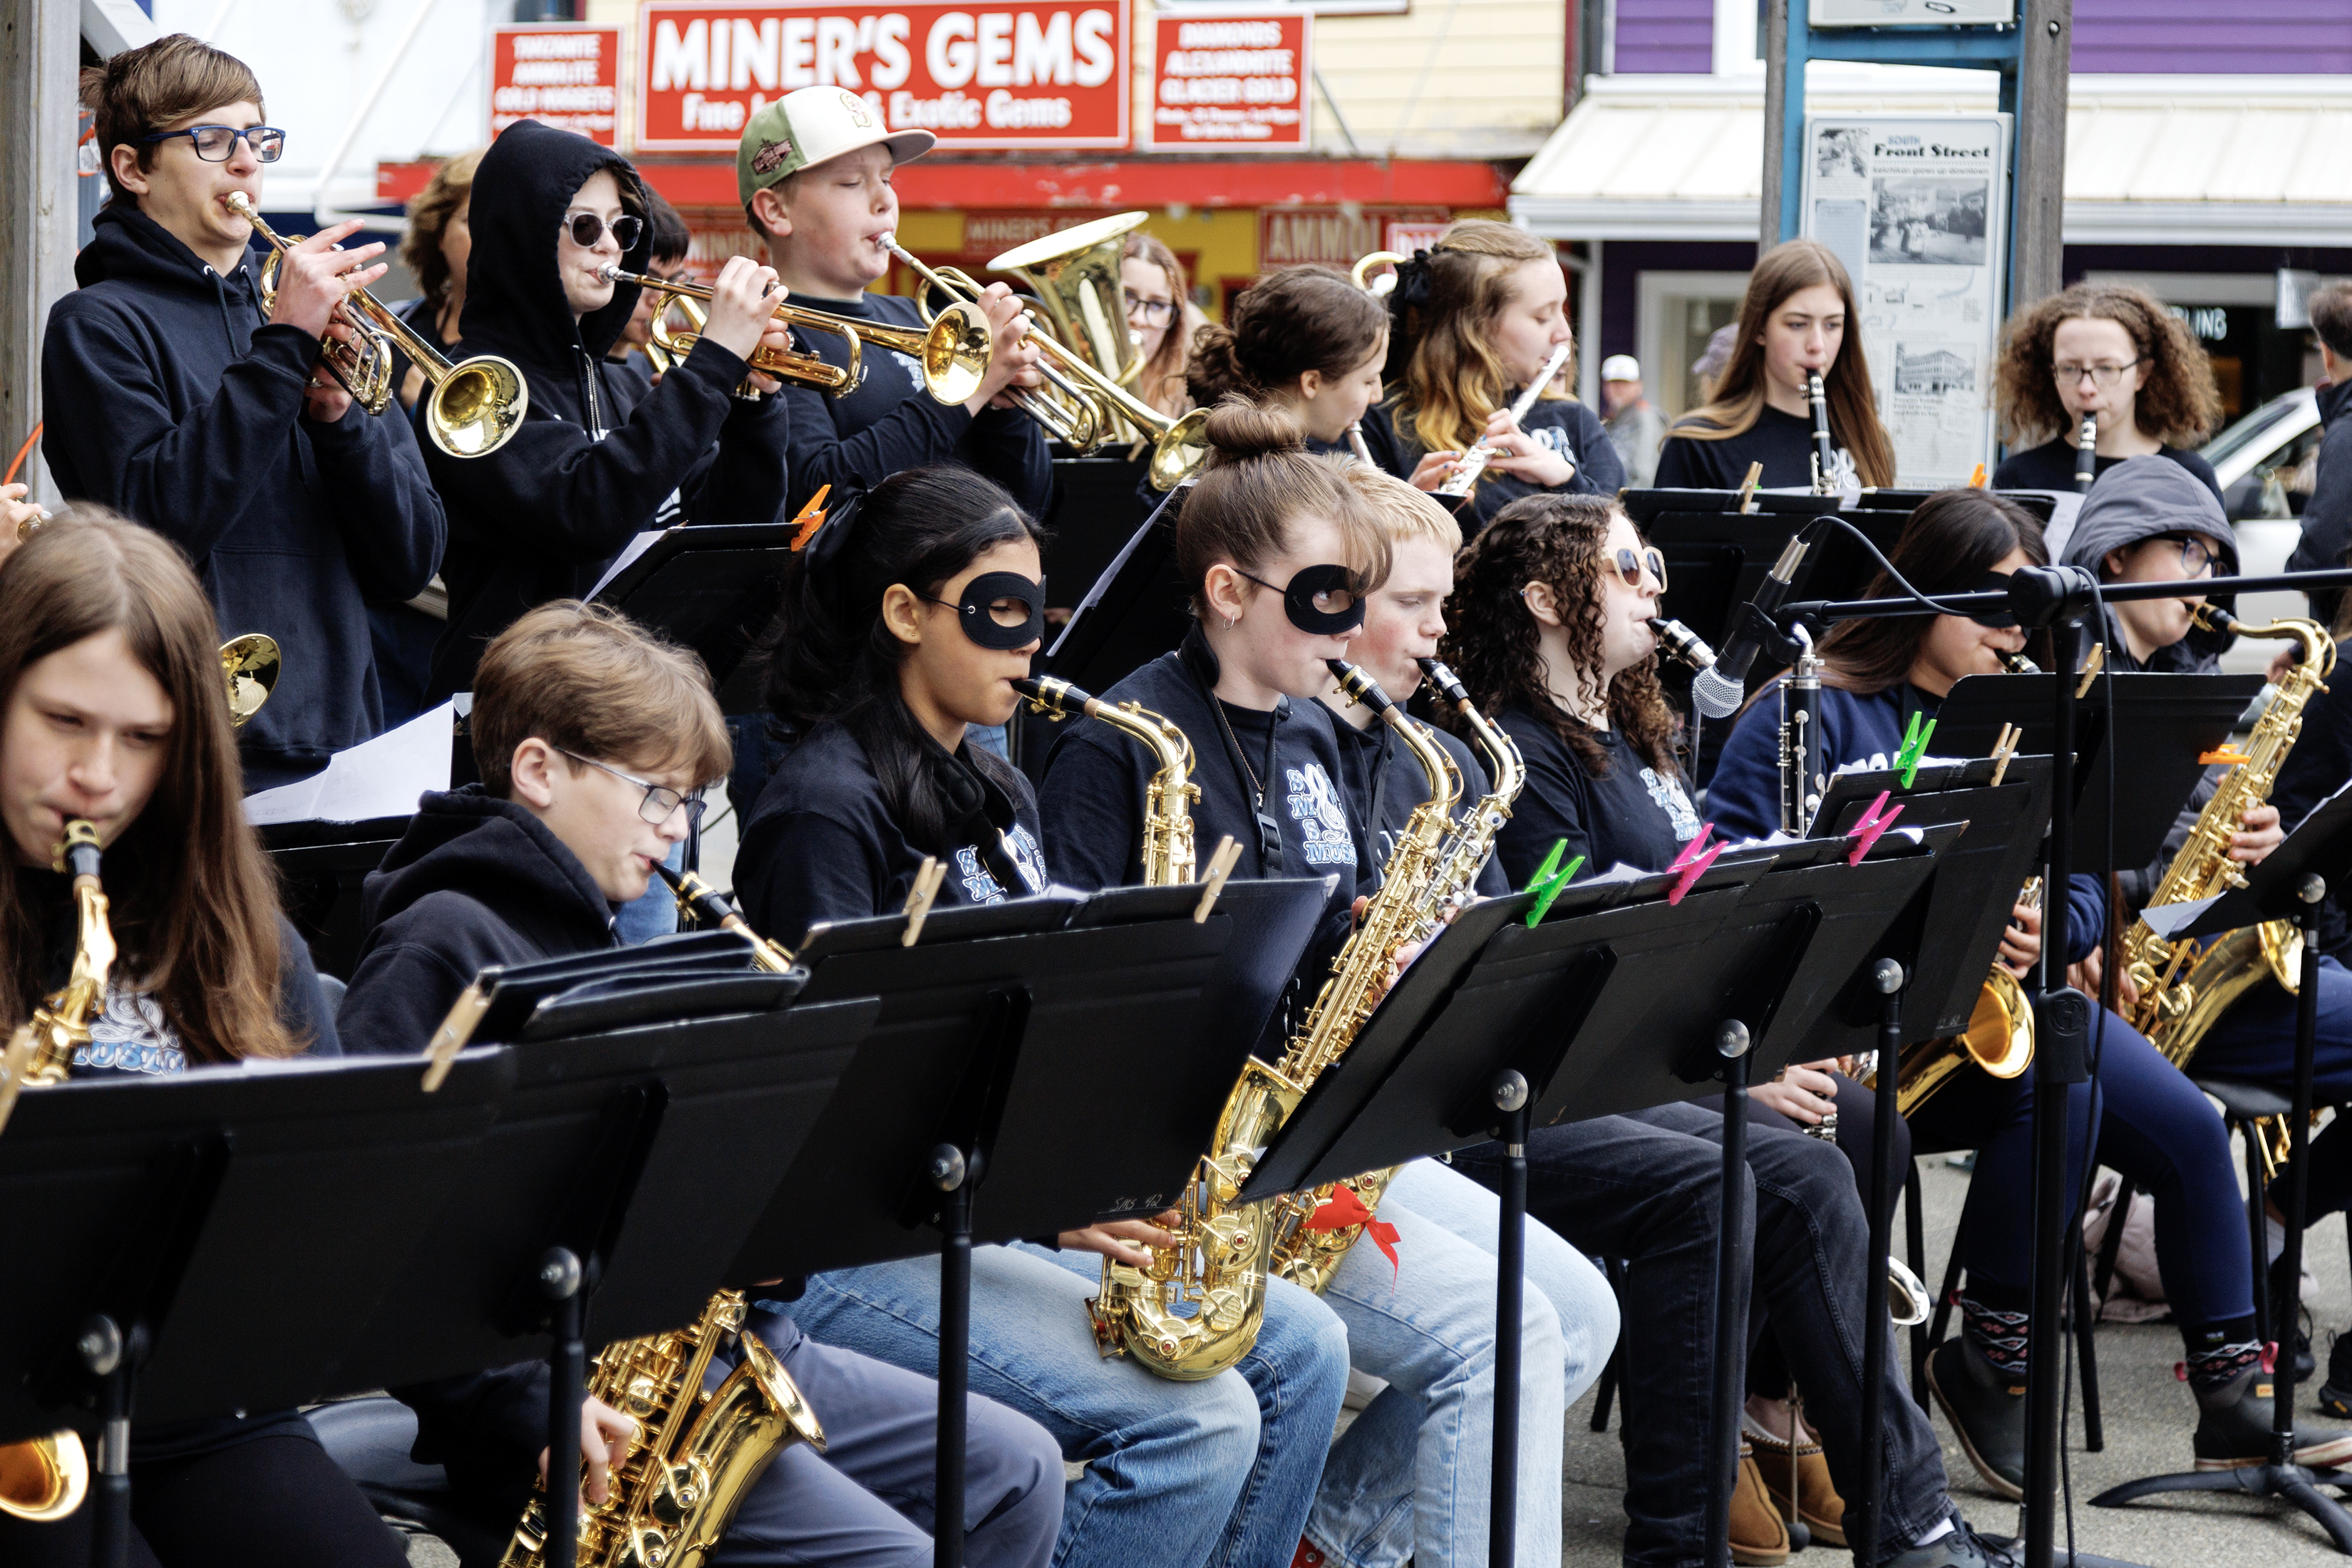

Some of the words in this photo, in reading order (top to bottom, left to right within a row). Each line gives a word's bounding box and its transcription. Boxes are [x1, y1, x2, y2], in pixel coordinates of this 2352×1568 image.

[651, 13, 912, 91] MINER'S
[926, 9, 1115, 89] GEMS
[495, 86, 539, 112] GOLD
[1242, 76, 1298, 104] GOLD
[682, 93, 746, 131] Fine
[889, 91, 982, 130] Exotic
[986, 88, 1073, 129] Gems
[1874, 144, 1924, 157] Front
[1931, 144, 1990, 157] Street
